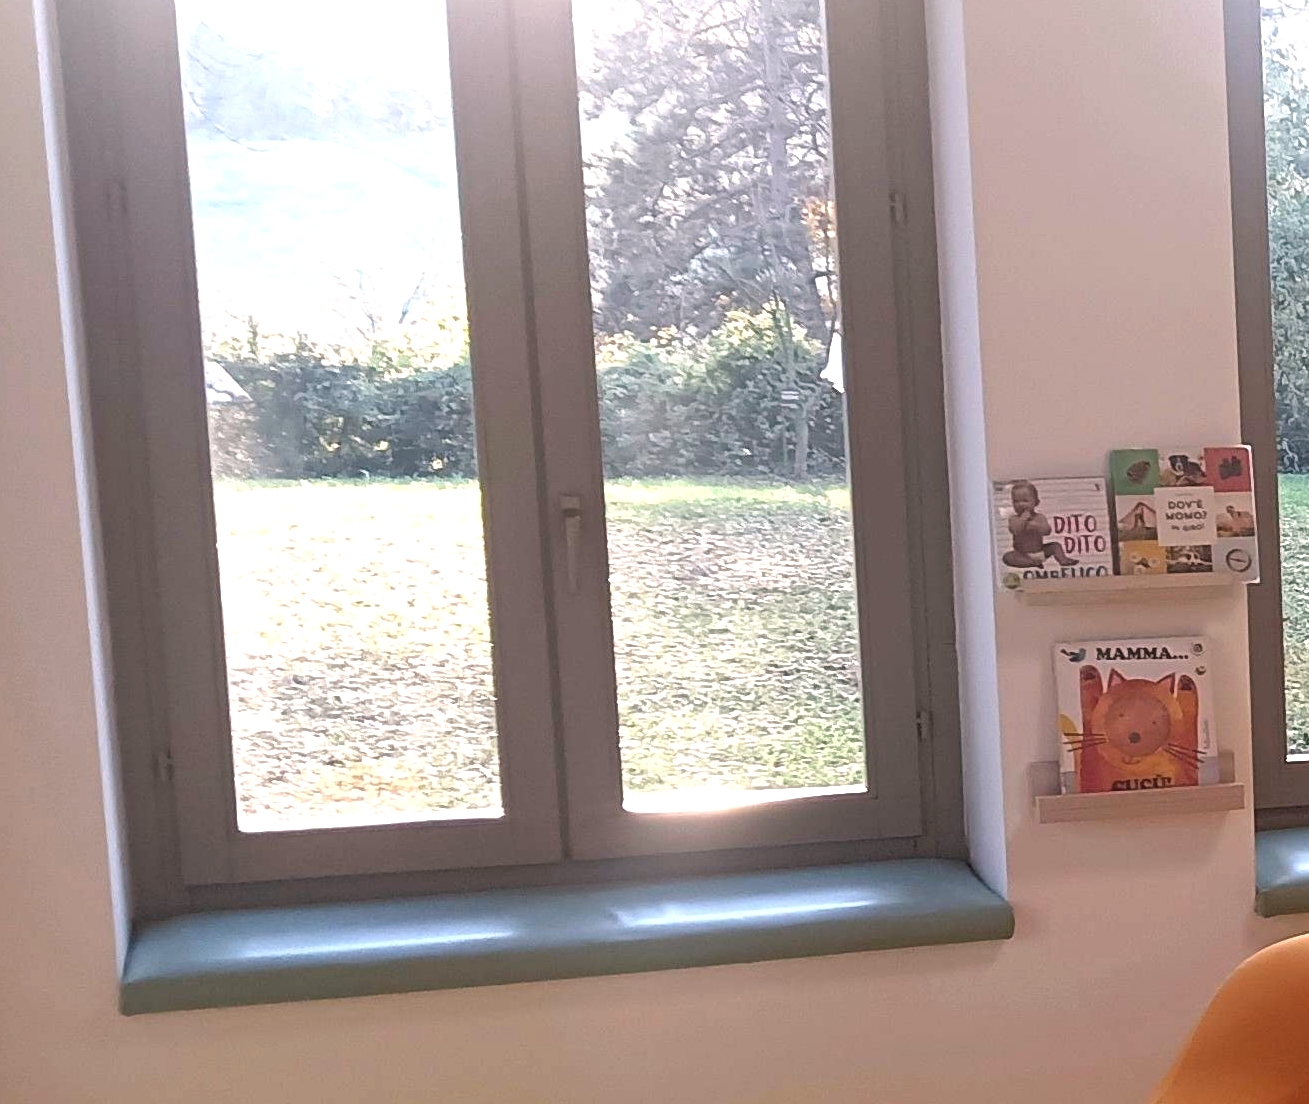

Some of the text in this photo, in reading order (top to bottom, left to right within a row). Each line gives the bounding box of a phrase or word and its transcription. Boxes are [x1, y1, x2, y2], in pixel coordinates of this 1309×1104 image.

[1053, 514, 1097, 534] DITO
[1064, 535, 1106, 554] DITO
[1096, 647, 1189, 660] MAMMA...
